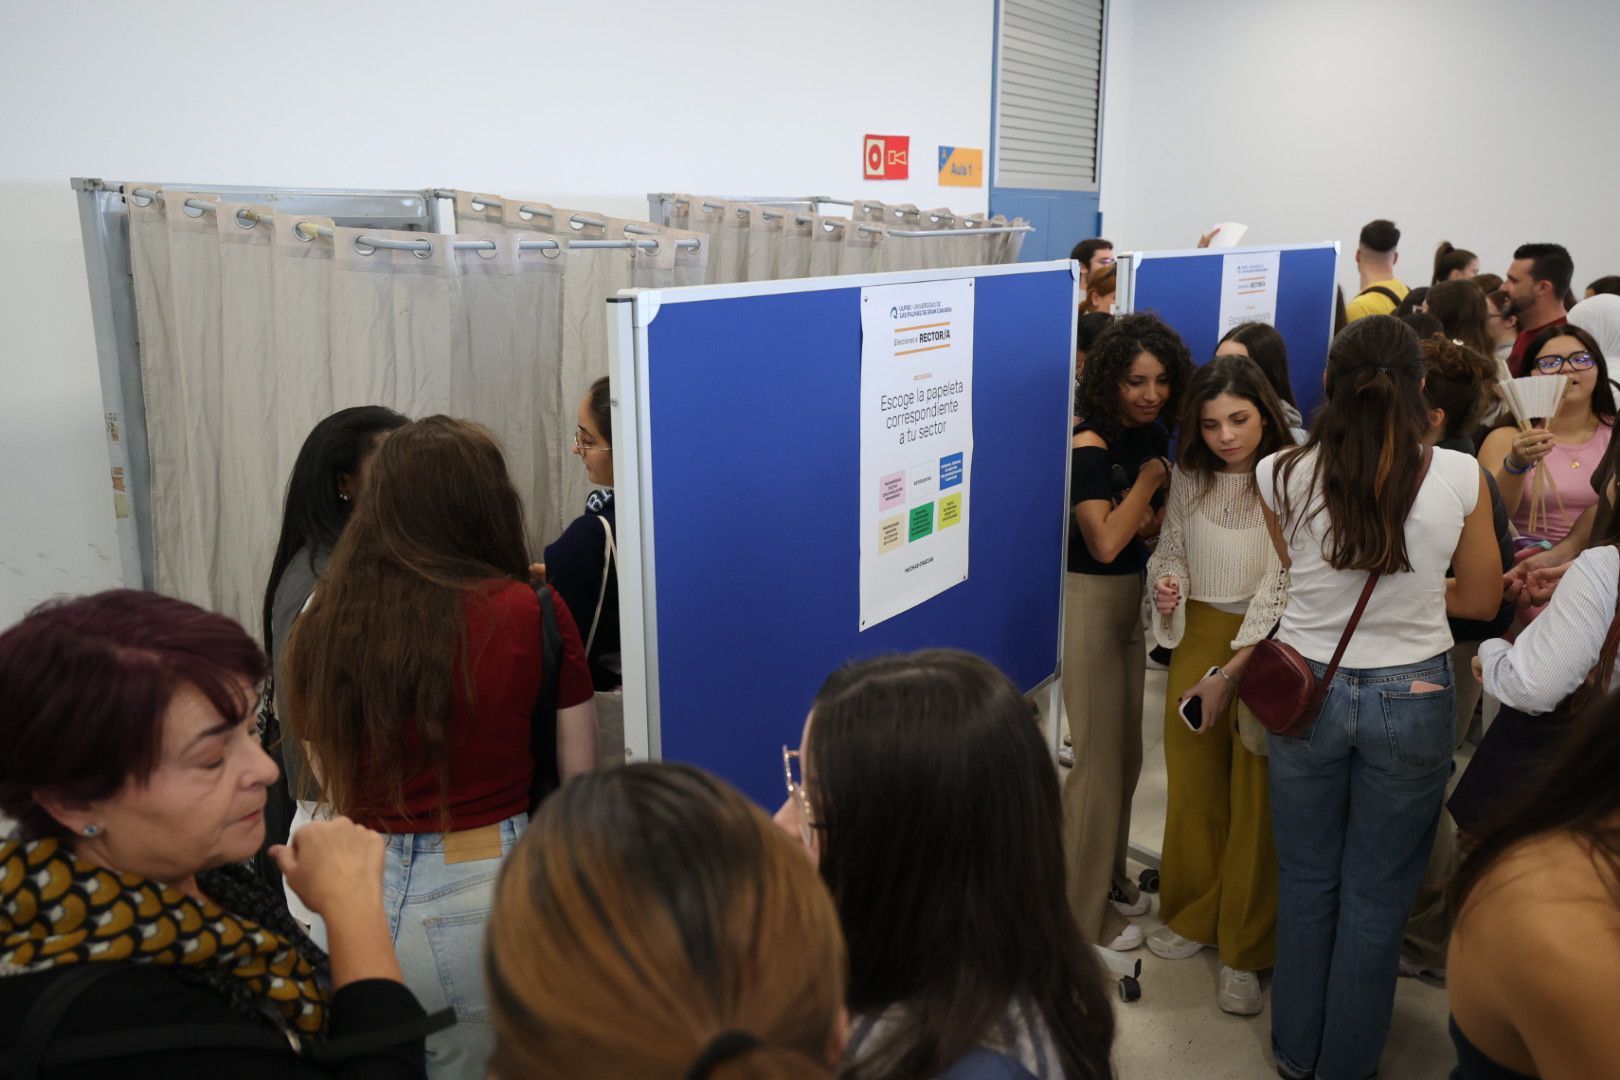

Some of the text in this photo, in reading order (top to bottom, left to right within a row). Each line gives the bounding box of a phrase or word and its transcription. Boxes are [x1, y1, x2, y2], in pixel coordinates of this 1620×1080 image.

[951, 163, 973, 176] Aula 1
[919, 329, 951, 343] RECTOR/A
[881, 380, 963, 411] Escoge la papeleta
[886, 399, 959, 429] correspondiente
[900, 421, 947, 445] a tu sector
